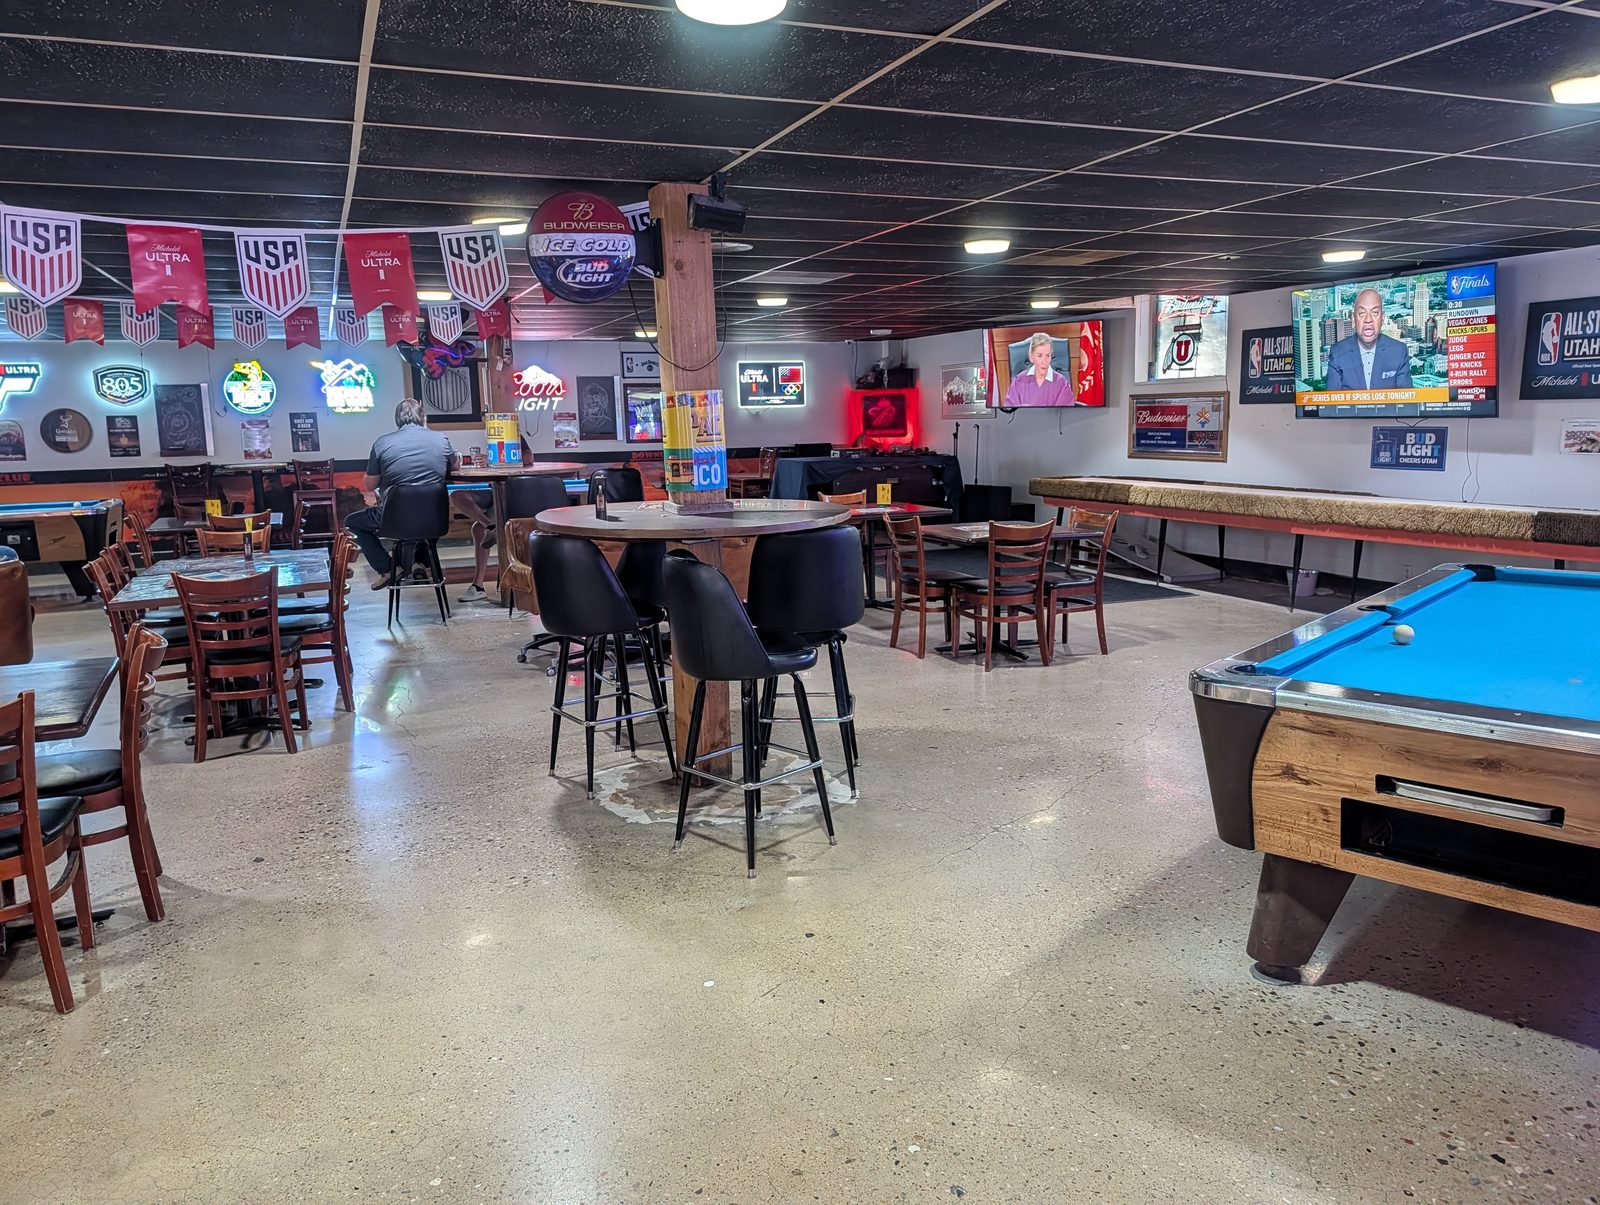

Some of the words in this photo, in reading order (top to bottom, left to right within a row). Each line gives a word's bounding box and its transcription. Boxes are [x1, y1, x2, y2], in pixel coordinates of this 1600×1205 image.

[543, 221, 625, 230] BUDWEISER
[11, 219, 72, 254] USA
[447, 234, 497, 264] USA
[541, 239, 575, 252] ICE
[581, 239, 631, 252] COLD
[145, 252, 191, 263] ULTRA
[243, 240, 299, 270] USA
[361, 257, 401, 268] ULTRA
[574, 262, 609, 272] BUD
[566, 273, 613, 283] LIGHT
[1458, 274, 1490, 295] Finals
[1448, 301, 1463, 309] 0:30
[235, 309, 263, 326] USA
[432, 306, 458, 321] USA
[1448, 309, 1479, 318] RUNDOWN
[1448, 316, 1488, 326] VEGAS/CANES
[1448, 326, 1488, 335] KNICKS/SPURS
[1176, 339, 1191, 362] U
[1449, 352, 1471, 361] GINGER
[5, 366, 38, 374] ULTRA
[1264, 358, 1285, 371] UTAH
[740, 374, 769, 383] ULTRA
[1449, 378, 1473, 386] ERRORS
[1531, 375, 1579, 387] Michelob
[102, 377, 143, 393] 805
[1312, 393, 1330, 402] SERIES
[1331, 393, 1345, 401] OVER
[1352, 392, 1371, 401] SPURS
[1371, 392, 1386, 400] LOSE
[1387, 391, 1417, 400] TONIGHT?
[1136, 410, 1188, 424] Budweiser
[1406, 433, 1436, 445] BUD
[1400, 445, 1440, 456] LIGHT
